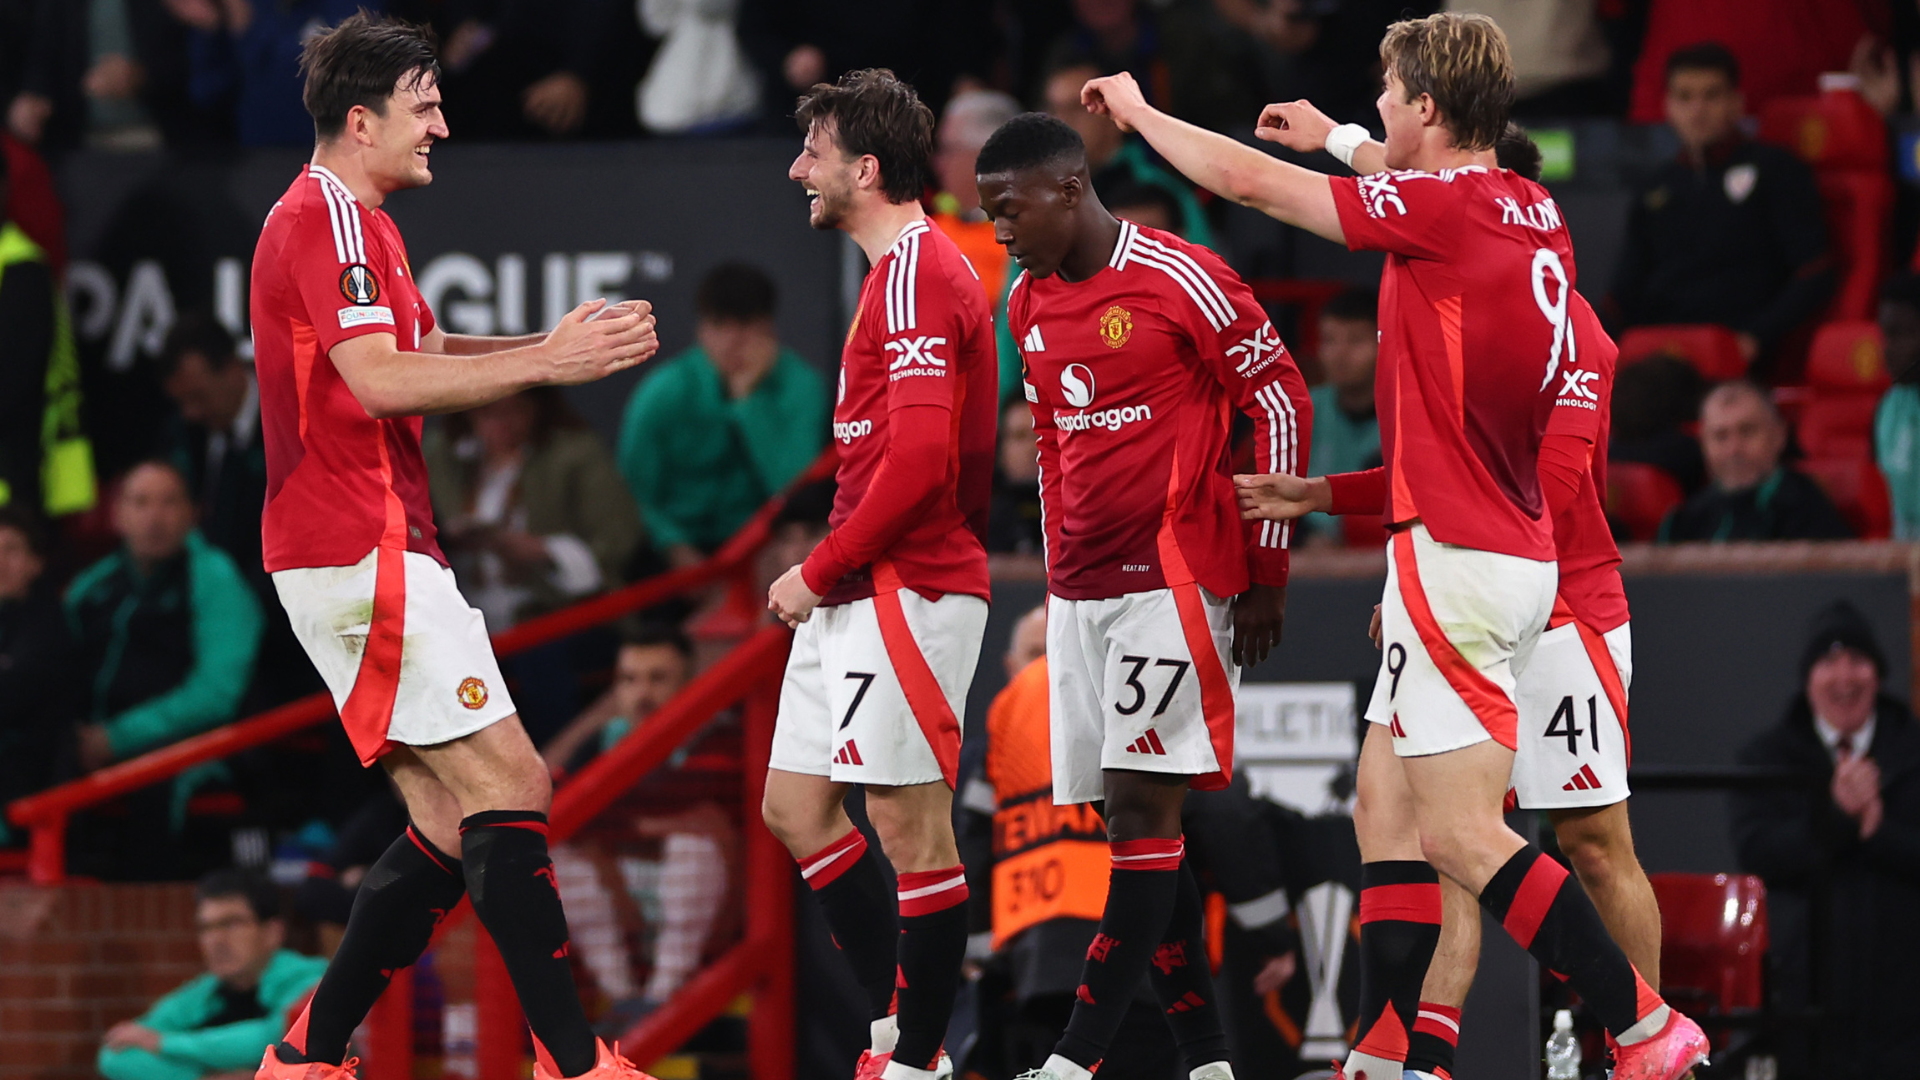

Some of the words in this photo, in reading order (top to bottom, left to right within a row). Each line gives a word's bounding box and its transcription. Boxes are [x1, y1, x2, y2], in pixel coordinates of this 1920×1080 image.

[1225, 319, 1281, 373] DXC
[1531, 247, 1569, 393] 9
[884, 336, 947, 372] DXC
[889, 368, 947, 382] TECHNOLOGY
[838, 671, 877, 732] 7
[1114, 655, 1191, 719] 37
[1388, 642, 1407, 703] 9
[1543, 693, 1600, 757] 41
